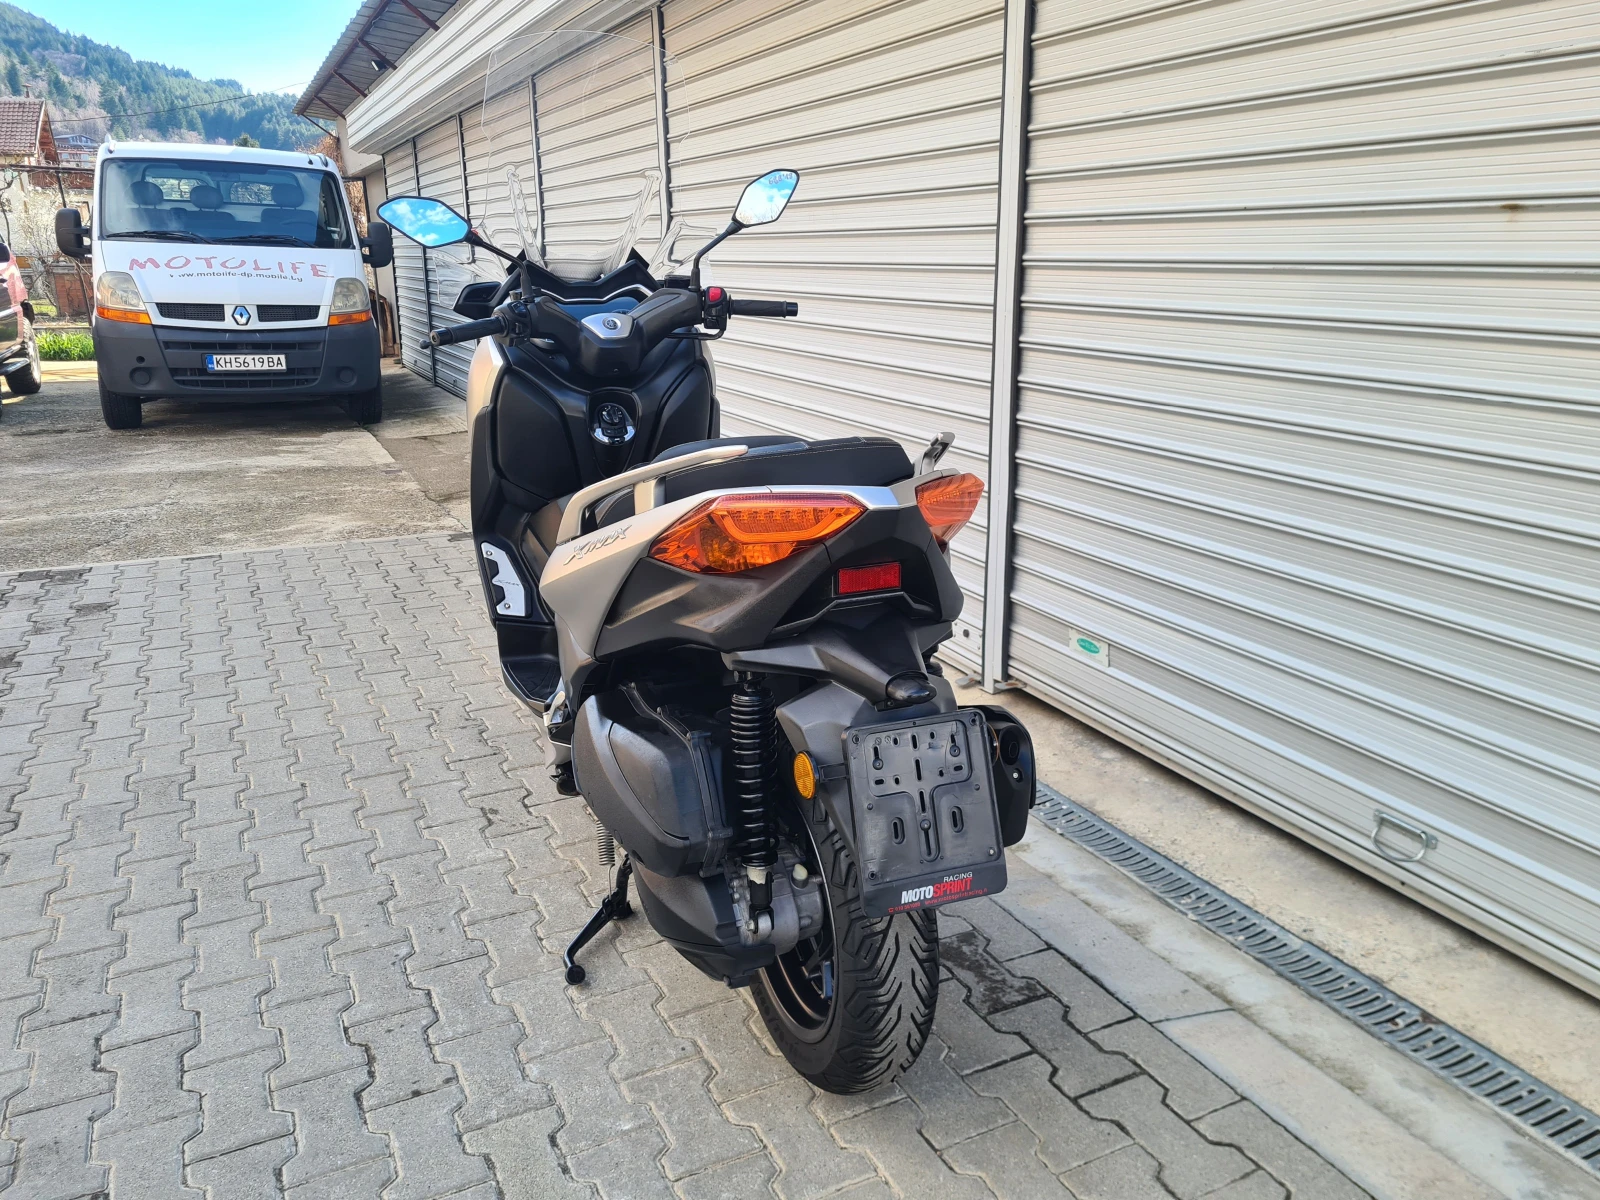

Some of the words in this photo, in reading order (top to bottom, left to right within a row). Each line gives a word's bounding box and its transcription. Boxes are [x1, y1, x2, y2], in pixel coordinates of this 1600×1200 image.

[129, 256, 334, 277] MOTOLIFE
[215, 356, 284, 368] KH5619BA
[943, 872, 972, 882] RACING
[901, 878, 972, 904] MOTOSPRINT
